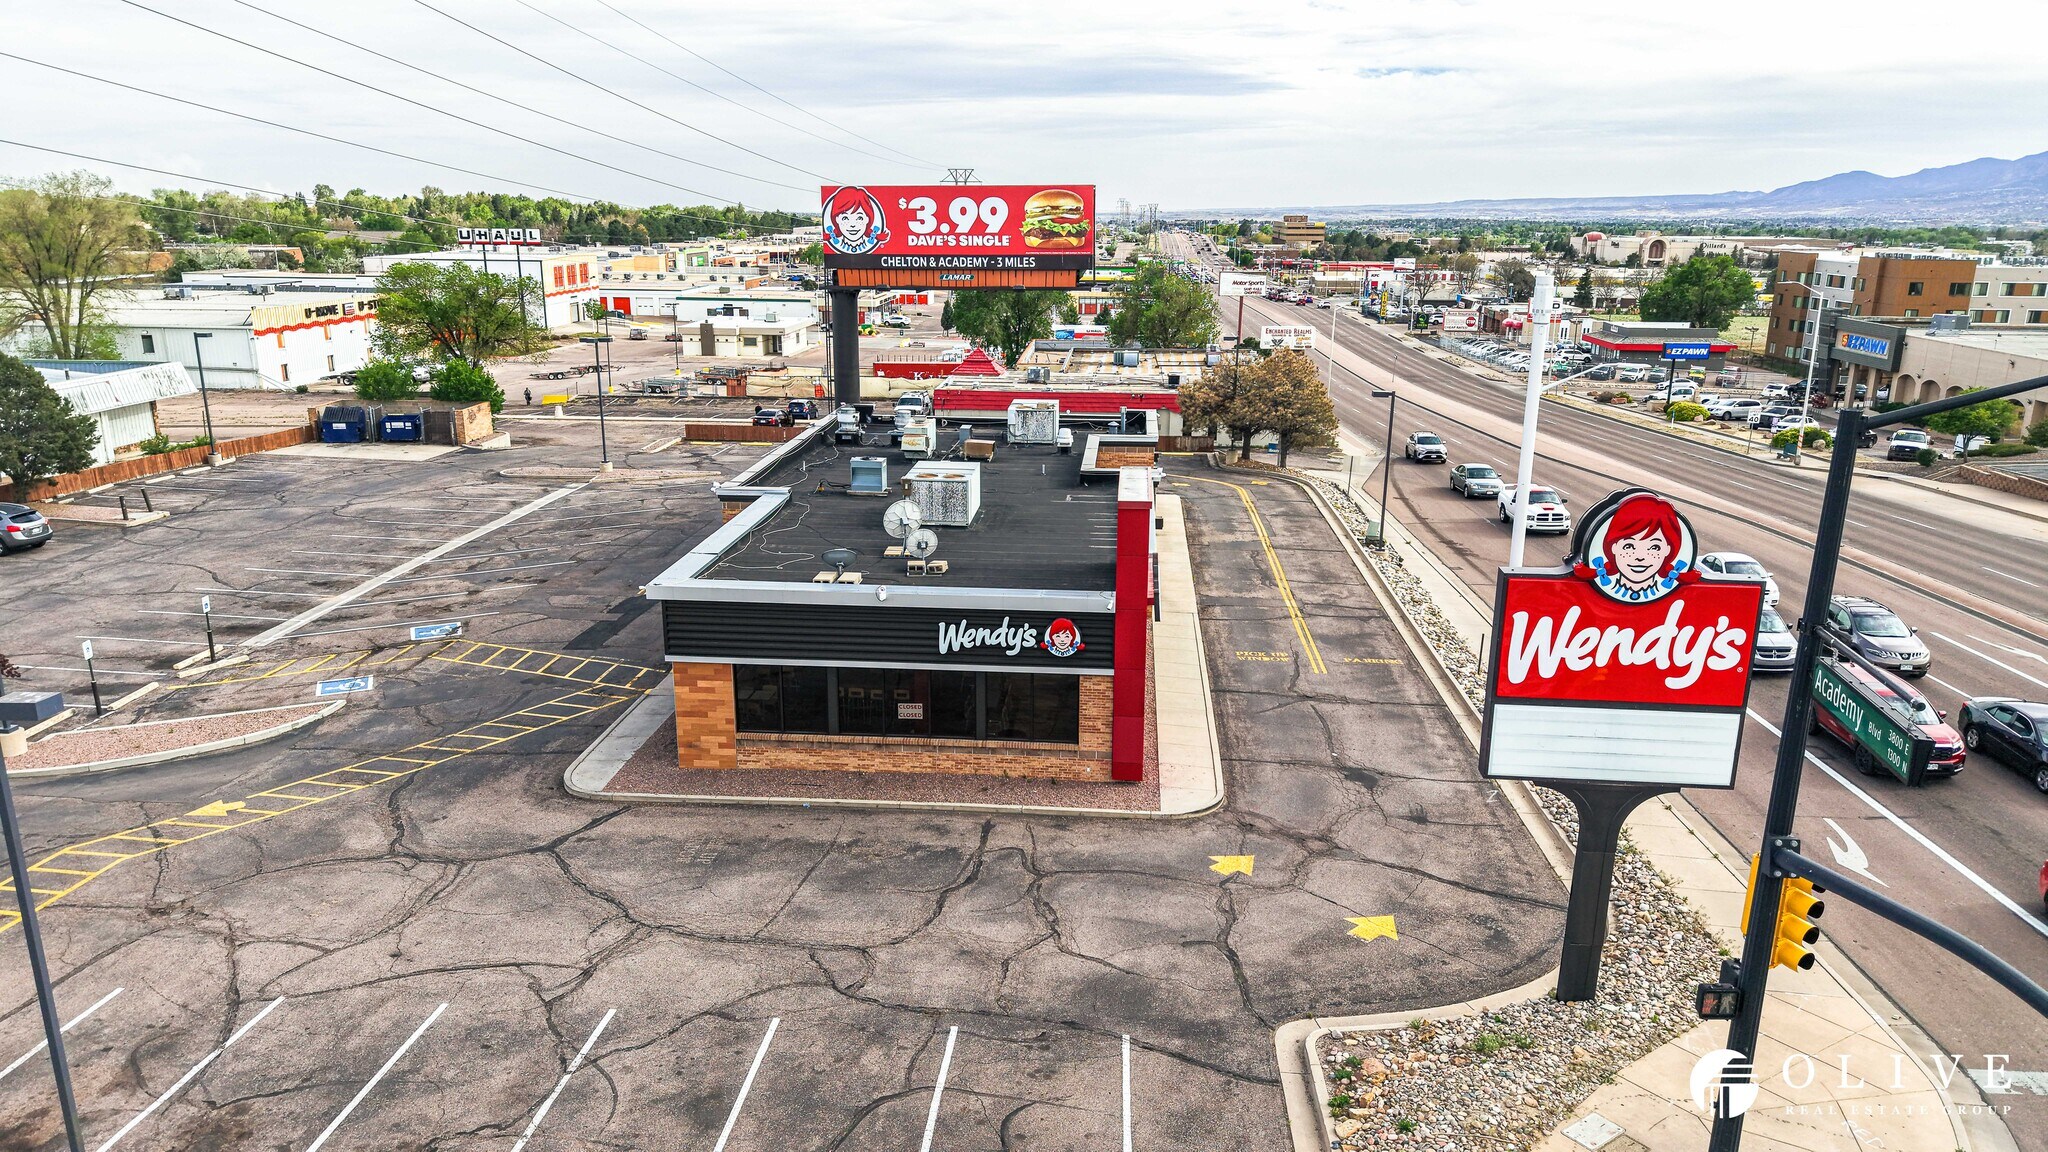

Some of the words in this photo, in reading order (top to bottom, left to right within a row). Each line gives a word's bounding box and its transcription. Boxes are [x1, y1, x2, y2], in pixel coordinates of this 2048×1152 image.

[898, 196, 1009, 234] $3.99
[907, 235, 957, 247] DAVE'S
[958, 235, 1010, 247] SINGLE
[881, 256, 928, 268] CHELTON
[929, 256, 937, 268] &
[938, 256, 989, 268] ACADEMY
[996, 257, 1003, 268] 3
[1005, 256, 1036, 268] MILES
[938, 616, 1037, 656] Wendy's
[1508, 599, 1747, 690] Wendy's
[1815, 669, 1864, 732] Academy
[1868, 721, 1882, 741] Blvd
[1888, 729, 1903, 750] 3800
[1904, 744, 1910, 756] E
[1887, 748, 1901, 768] 1300
[1901, 762, 1908, 774] N
